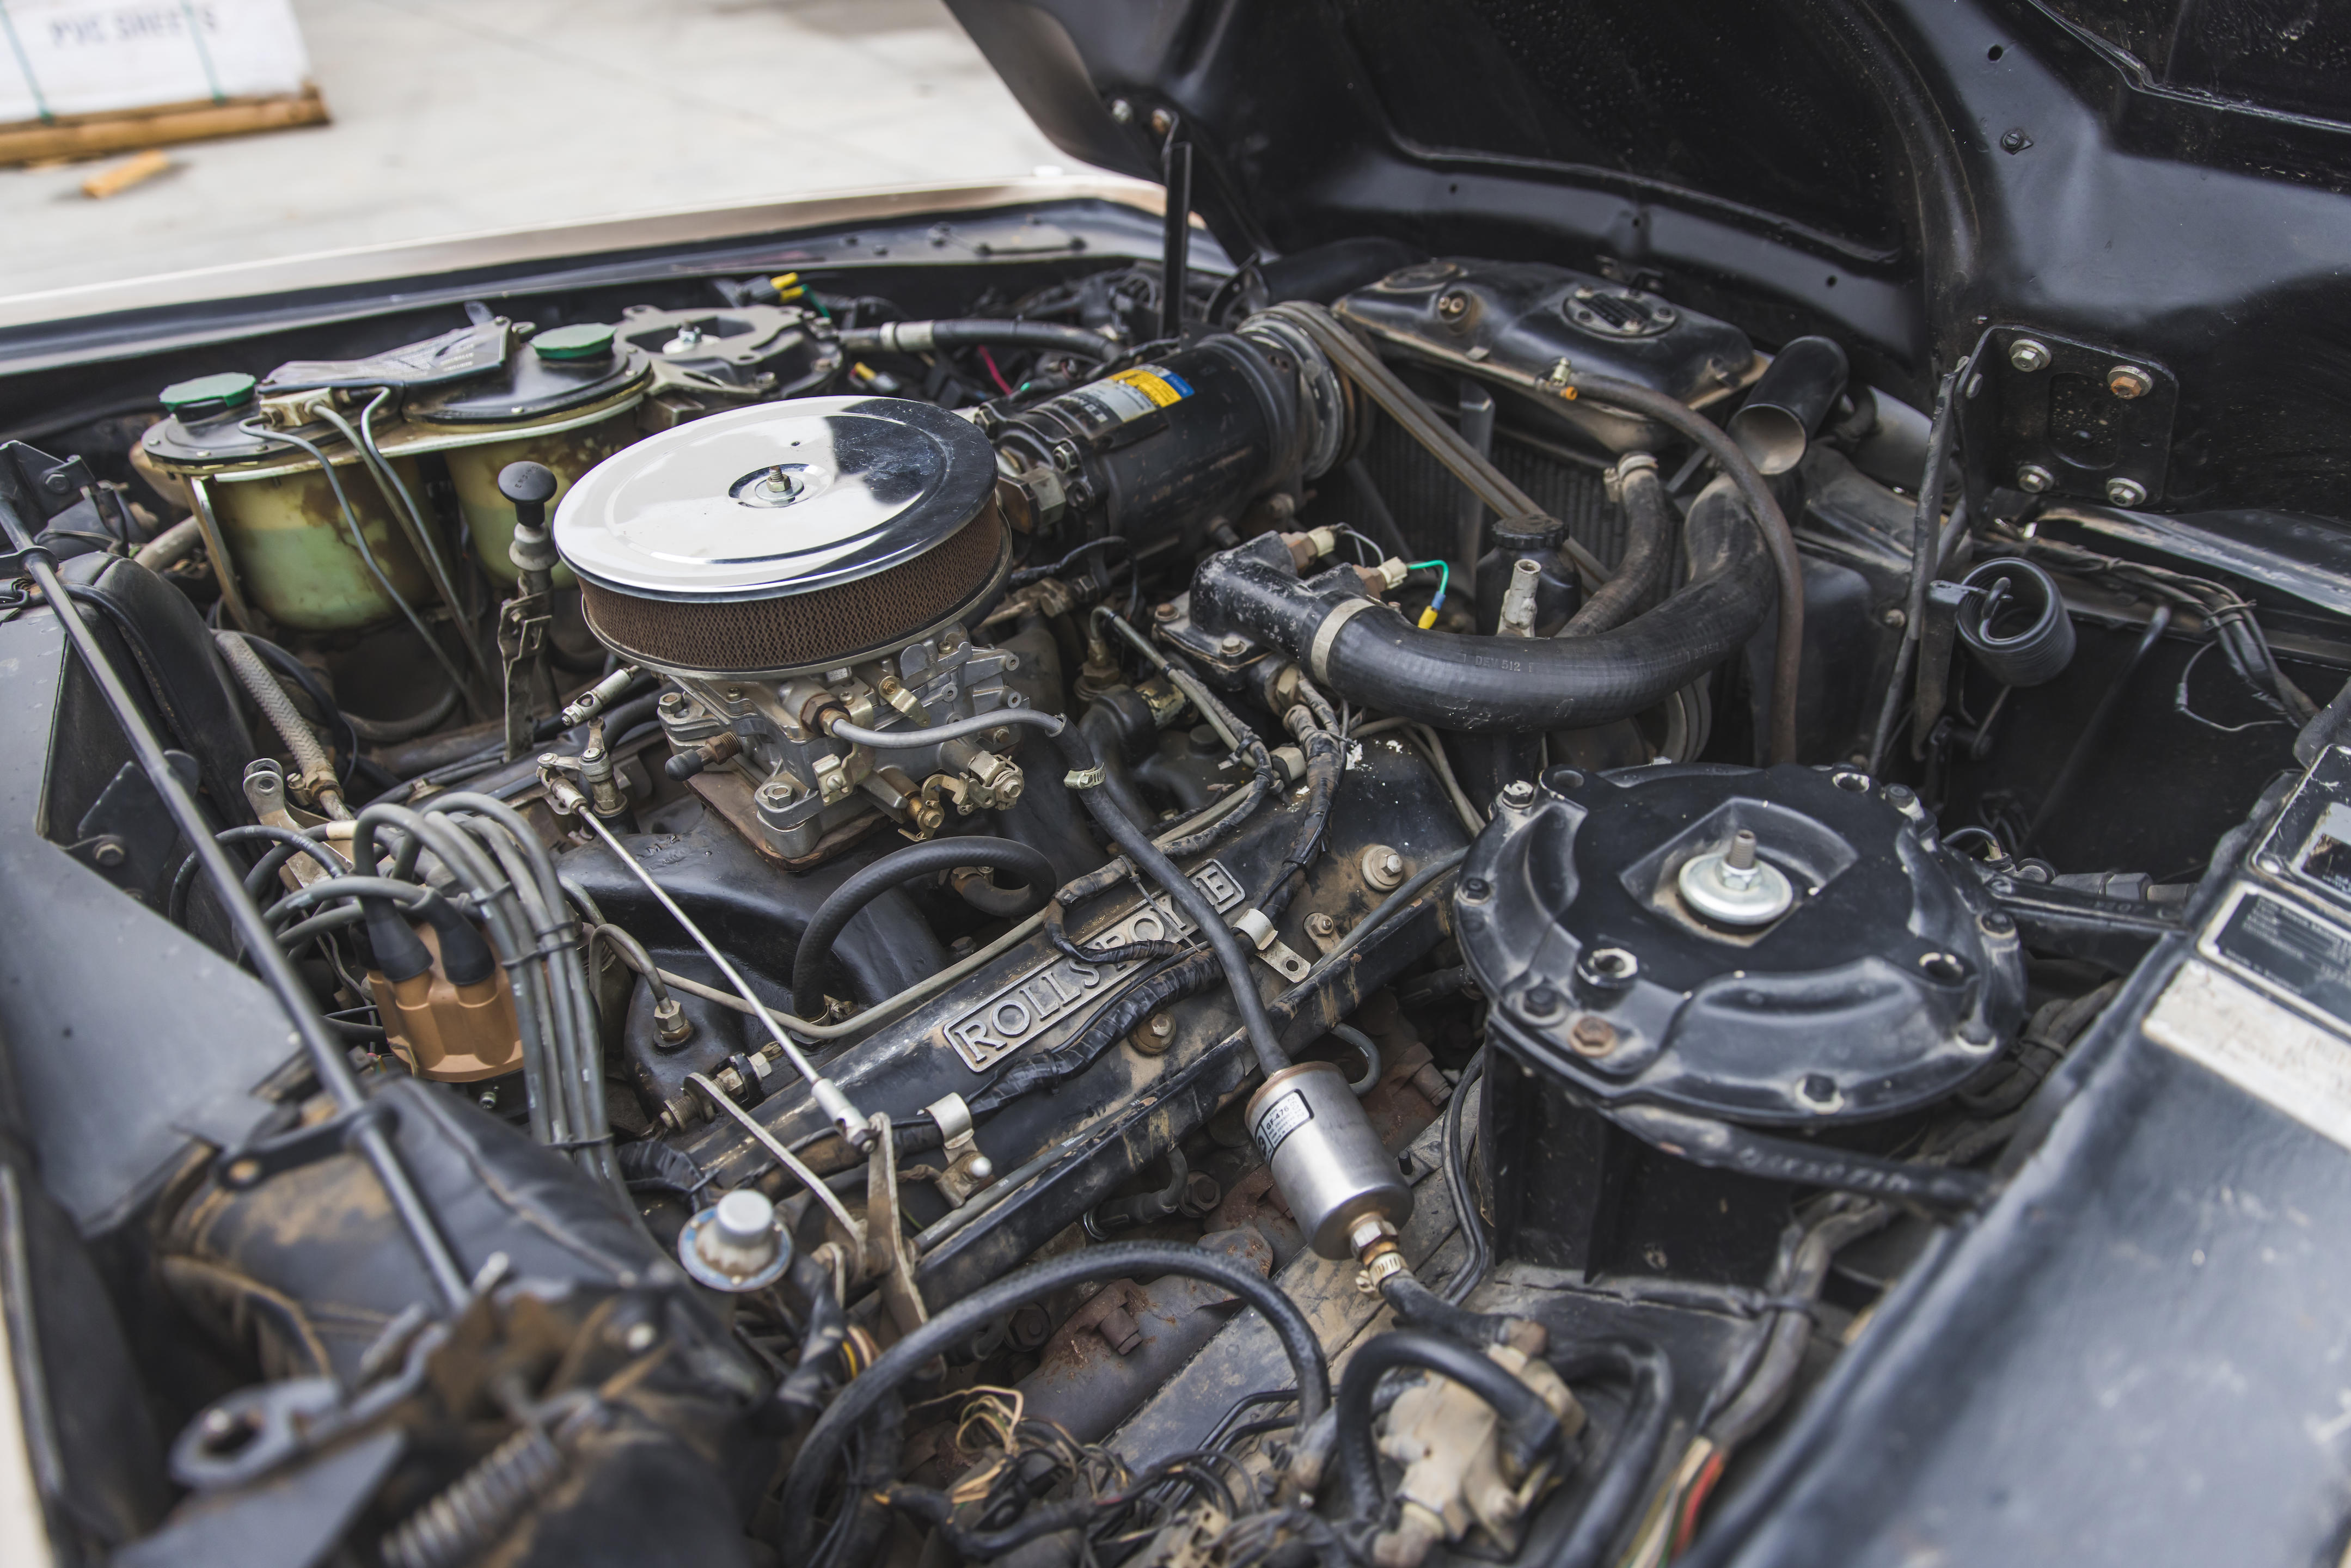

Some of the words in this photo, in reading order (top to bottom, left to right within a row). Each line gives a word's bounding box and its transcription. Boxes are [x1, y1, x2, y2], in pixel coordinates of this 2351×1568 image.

[115, 8, 218, 40] SHEES
[1475, 655, 1498, 668] DEV
[1501, 659, 1521, 671] 512
[955, 958, 1100, 1062] ROLLS
[1094, 870, 1235, 970] ROYE
[1266, 1106, 1289, 1130] GF-476
